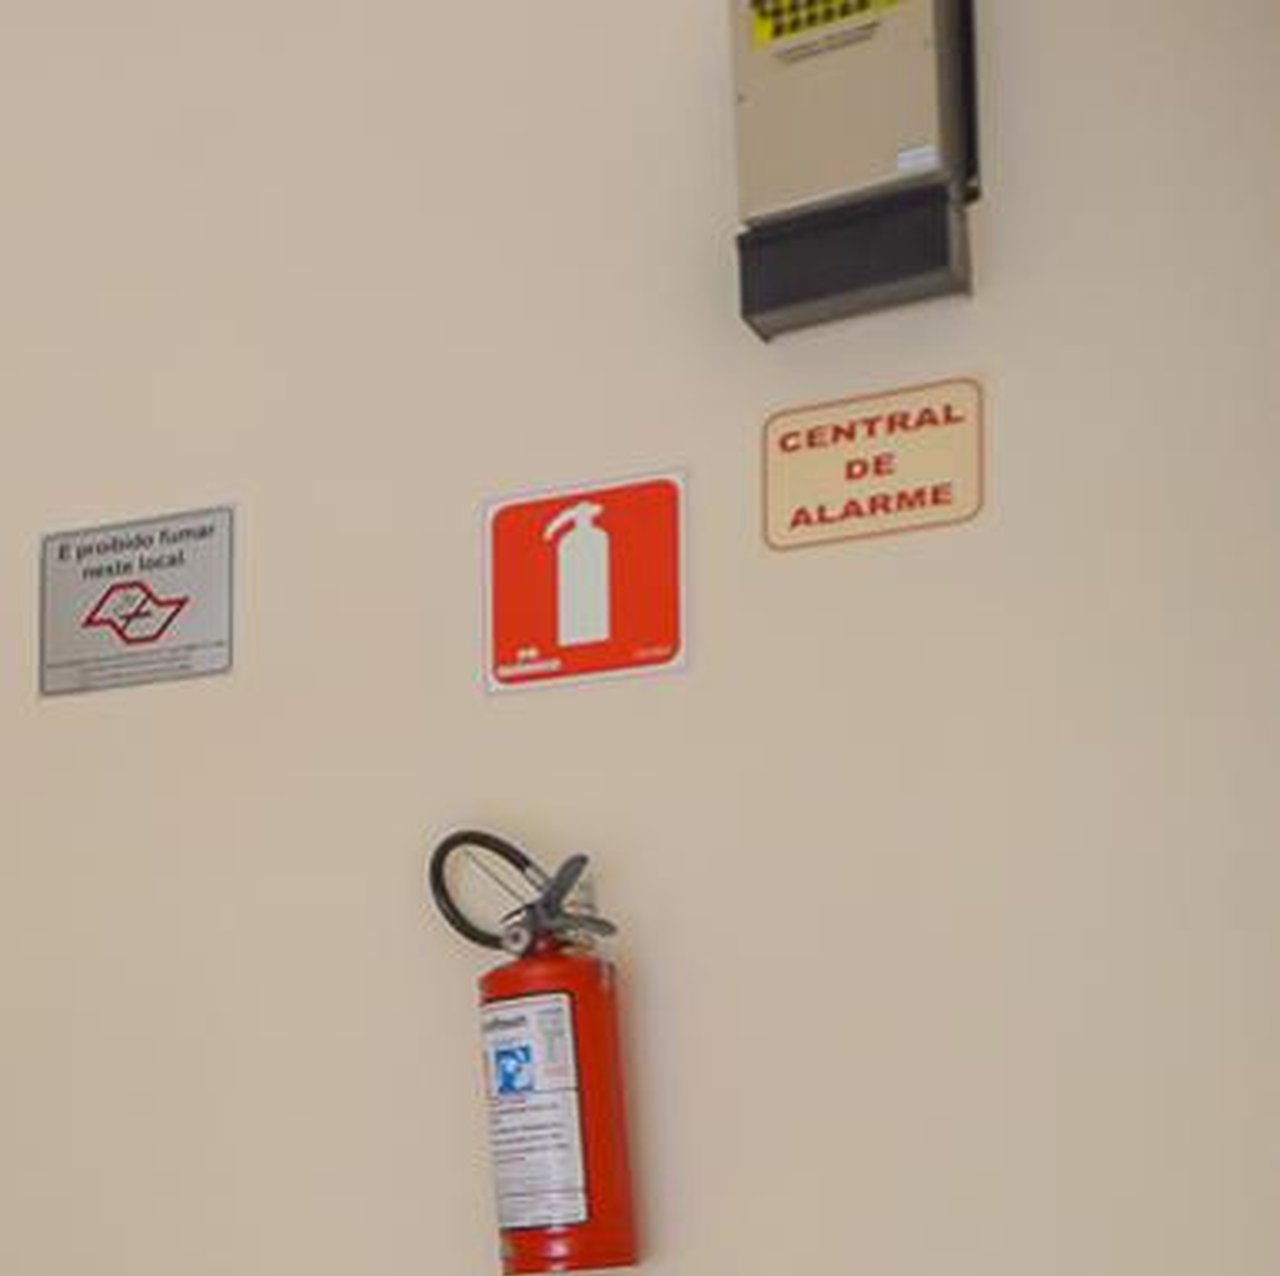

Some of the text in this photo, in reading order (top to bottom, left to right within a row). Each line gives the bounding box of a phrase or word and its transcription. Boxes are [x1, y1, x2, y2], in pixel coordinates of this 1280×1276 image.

[779, 404, 965, 453] CENTRAL
[845, 453, 895, 480] DE
[790, 482, 954, 530] ALARME
[75, 532, 154, 563] proibido
[159, 524, 215, 545] fumar
[82, 560, 133, 580] neste
